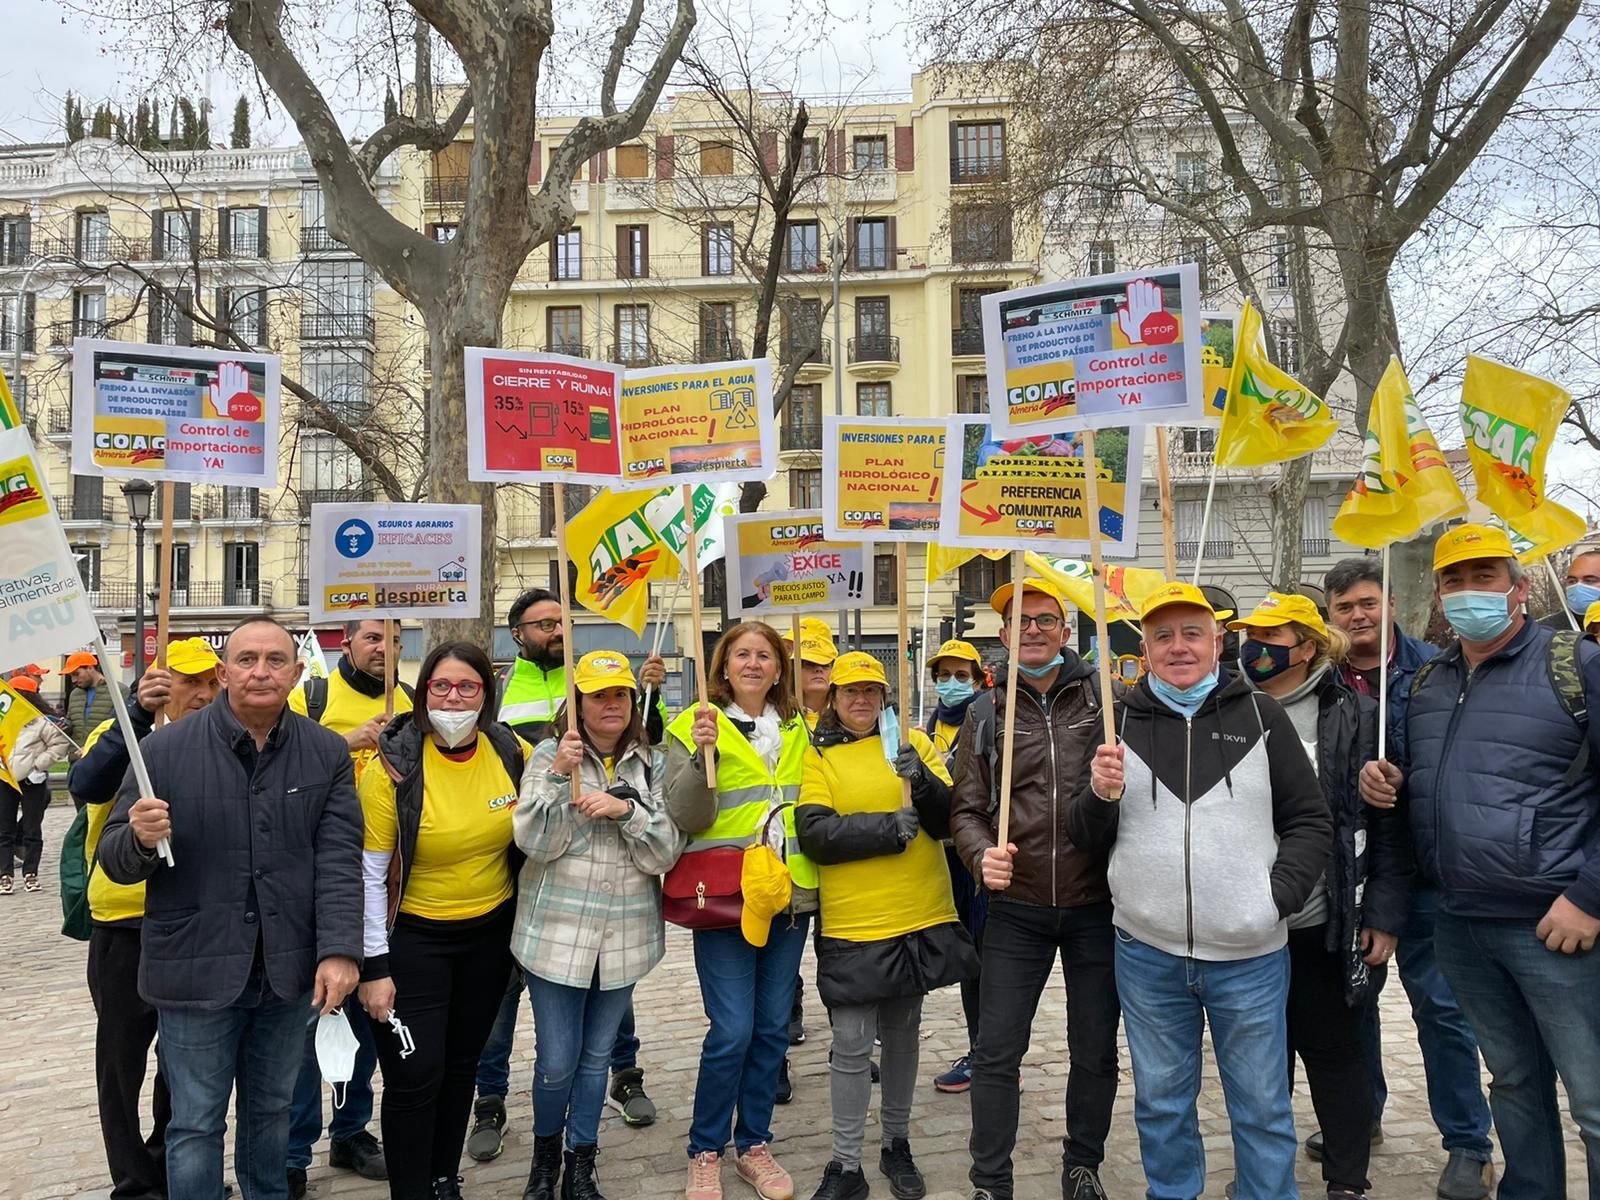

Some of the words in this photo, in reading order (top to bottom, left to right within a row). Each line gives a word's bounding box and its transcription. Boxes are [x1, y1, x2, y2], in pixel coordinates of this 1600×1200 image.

[1053, 308, 1093, 320] SCHMITZ
[1007, 332, 1034, 343] FRENO
[1036, 330, 1042, 338] A
[1044, 327, 1055, 337] LA
[1057, 319, 1103, 334] INVASIÓN
[1143, 325, 1175, 336] STOP
[1016, 344, 1027, 353] DE
[1028, 335, 1081, 351] PRODUCTOS
[1083, 333, 1095, 342] DE
[1017, 351, 1061, 365] TERCEROS
[1062, 344, 1095, 358] PAÍSES
[1089, 353, 1145, 372] Control
[1149, 351, 1168, 364] de
[148, 373, 188, 384] SCHMITZ
[518, 367, 532, 375] SIN
[533, 367, 588, 381] RENTABILIDAD
[492, 374, 551, 389] CIERRE
[556, 379, 567, 389] Y
[570, 381, 613, 398] RUINA!
[681, 379, 710, 391] PARA
[712, 378, 726, 388] EL
[727, 374, 755, 386] AGUA
[1076, 369, 1184, 394] Importaciones
[99, 383, 127, 393] FRENO
[130, 385, 136, 393] A
[138, 385, 149, 394] LA
[151, 386, 196, 397] INVASIÓN
[107, 395, 119, 403] DE
[121, 396, 174, 407] PRODUCTOS
[176, 398, 188, 407] DE
[1118, 393, 1142, 406] YA!
[108, 405, 153, 415] TERCEROS
[154, 406, 187, 417] PAÍSES
[230, 404, 258, 412] STOP
[643, 404, 681, 417] PLAN
[621, 414, 708, 432] HIDROLÓGICO
[179, 423, 230, 437] Control
[233, 426, 250, 437] de
[628, 427, 698, 443] NACIONAL
[841, 432, 904, 444] INVERSIONES
[907, 434, 936, 444] PARA
[166, 438, 263, 455] Importaciones
[202, 457, 225, 468] YA!
[628, 458, 665, 472] COAG
[695, 459, 748, 472] despierta
[864, 458, 904, 466] PLAN
[989, 458, 1097, 468] SOBERANÍ
[839, 468, 931, 480] HIDROLÓGICO
[979, 470, 1109, 479] ALIMENTARA
[847, 483, 919, 492] NACIONAL
[1001, 486, 1082, 501] PREFERENCIA
[843, 511, 883, 521] COAG
[998, 503, 1083, 519] COMUNITARIA
[378, 520, 413, 529] SEGUROS
[415, 520, 454, 529] AGRARIOS
[1016, 519, 1055, 529] COAG
[378, 533, 453, 545] EFICACES
[793, 553, 842, 572] EXIGE
[0, 571, 52, 596] rativas
[827, 572, 847, 584] YA
[773, 582, 800, 592] PRECIOS
[800, 581, 825, 590] JUSTOS
[375, 588, 467, 608] despierta
[774, 592, 792, 601] PARA
[792, 592, 801, 600] EL
[801, 590, 825, 600] CAMPO
